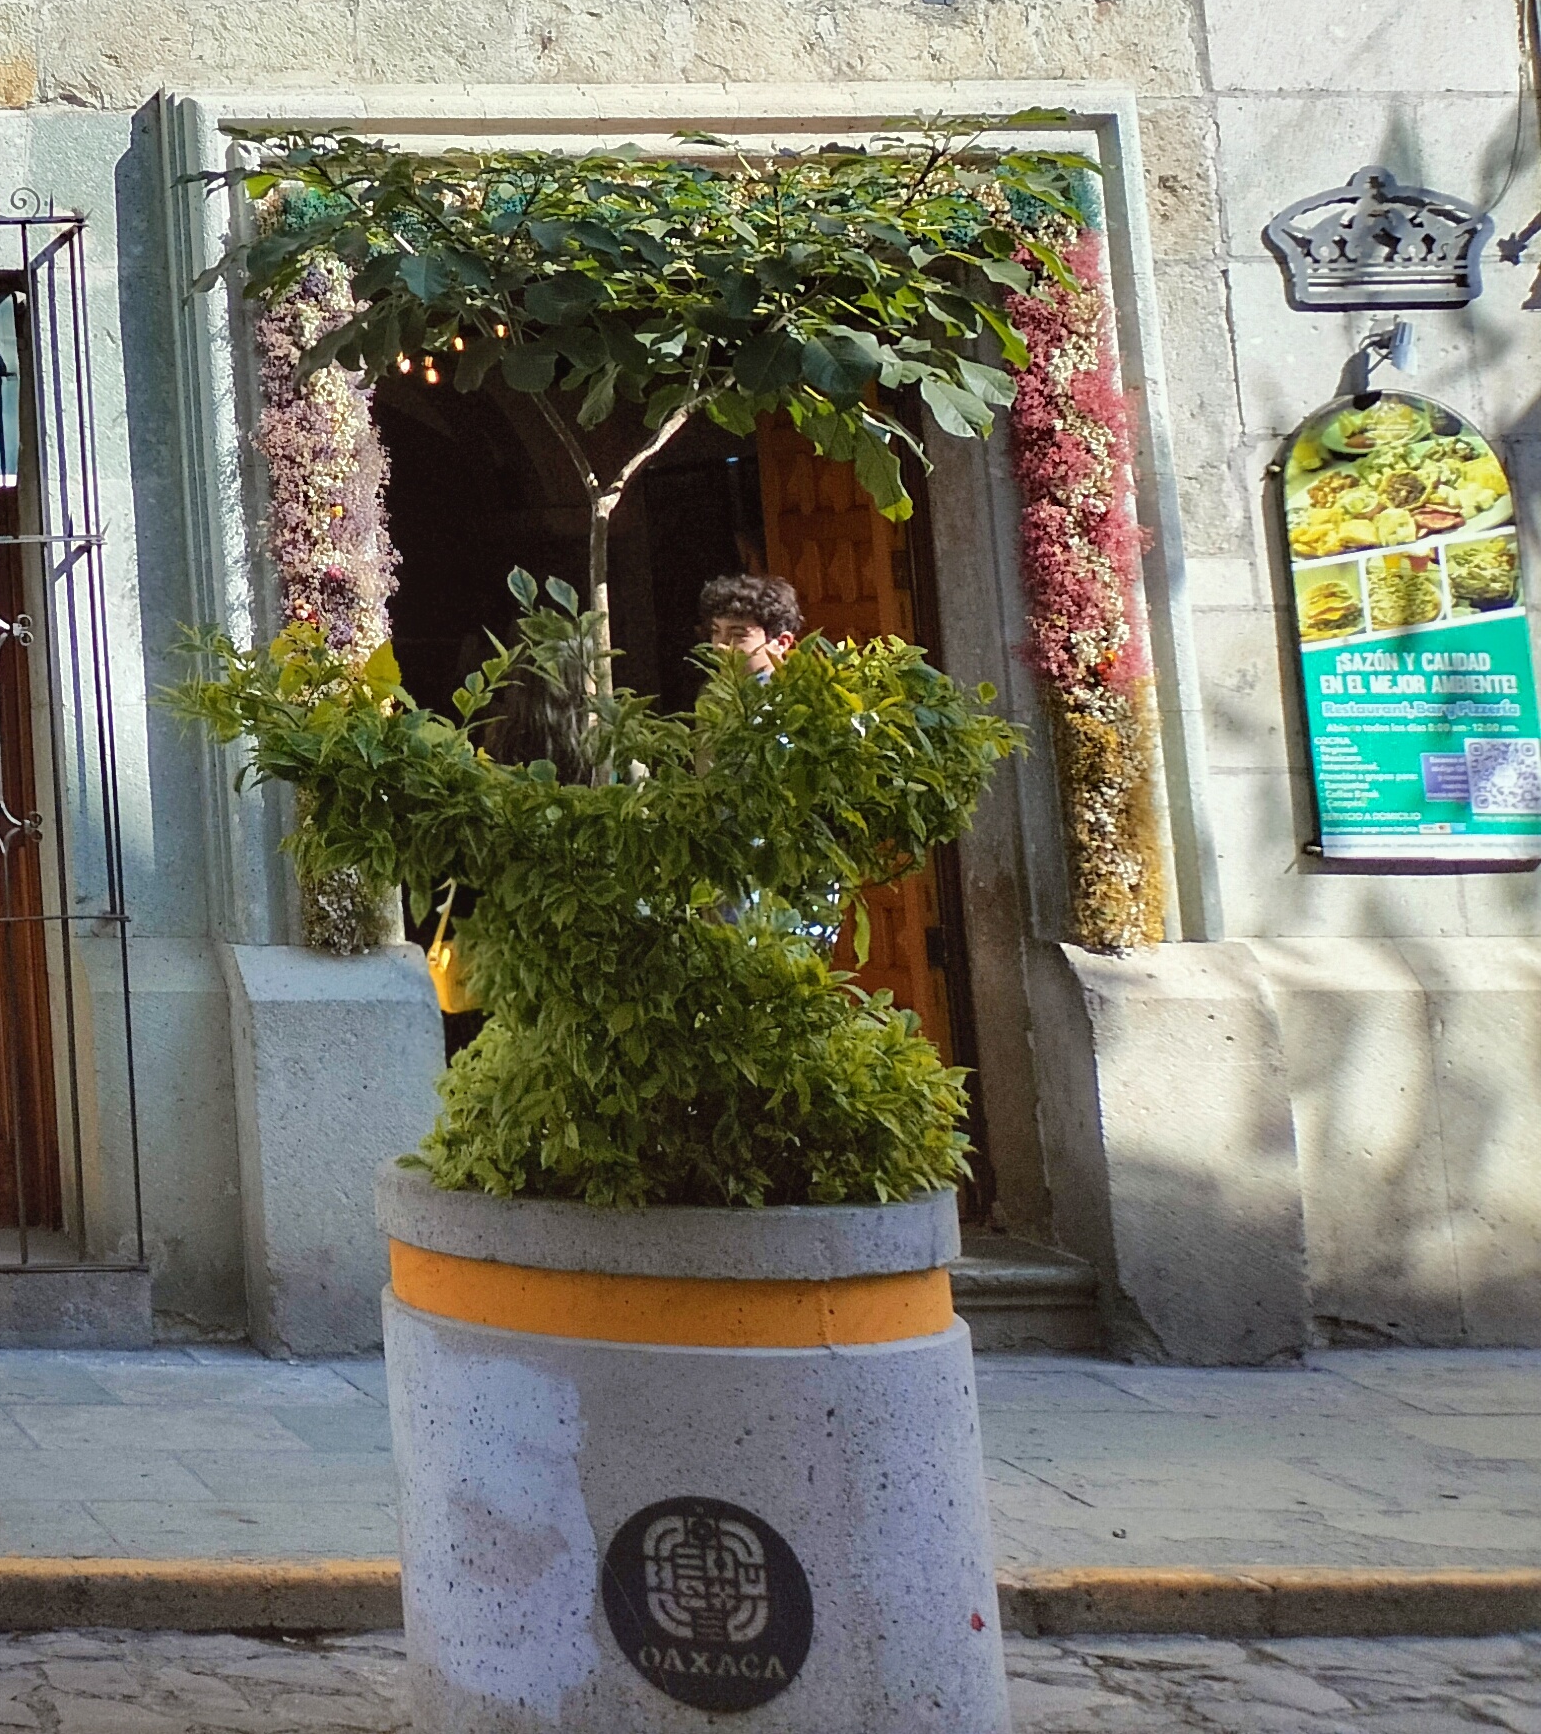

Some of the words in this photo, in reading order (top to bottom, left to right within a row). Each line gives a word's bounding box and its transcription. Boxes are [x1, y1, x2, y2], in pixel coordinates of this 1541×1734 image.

[1336, 649, 1399, 674] ¡SAZÓN
[1403, 652, 1415, 671] Y
[1421, 652, 1491, 672] CALIDAD
[1320, 675, 1344, 694] EN
[1346, 675, 1367, 694] EL
[1369, 675, 1426, 694] MEJOR
[1431, 675, 1519, 694] AMBIENTE!
[637, 1644, 788, 1680] OAXACA
